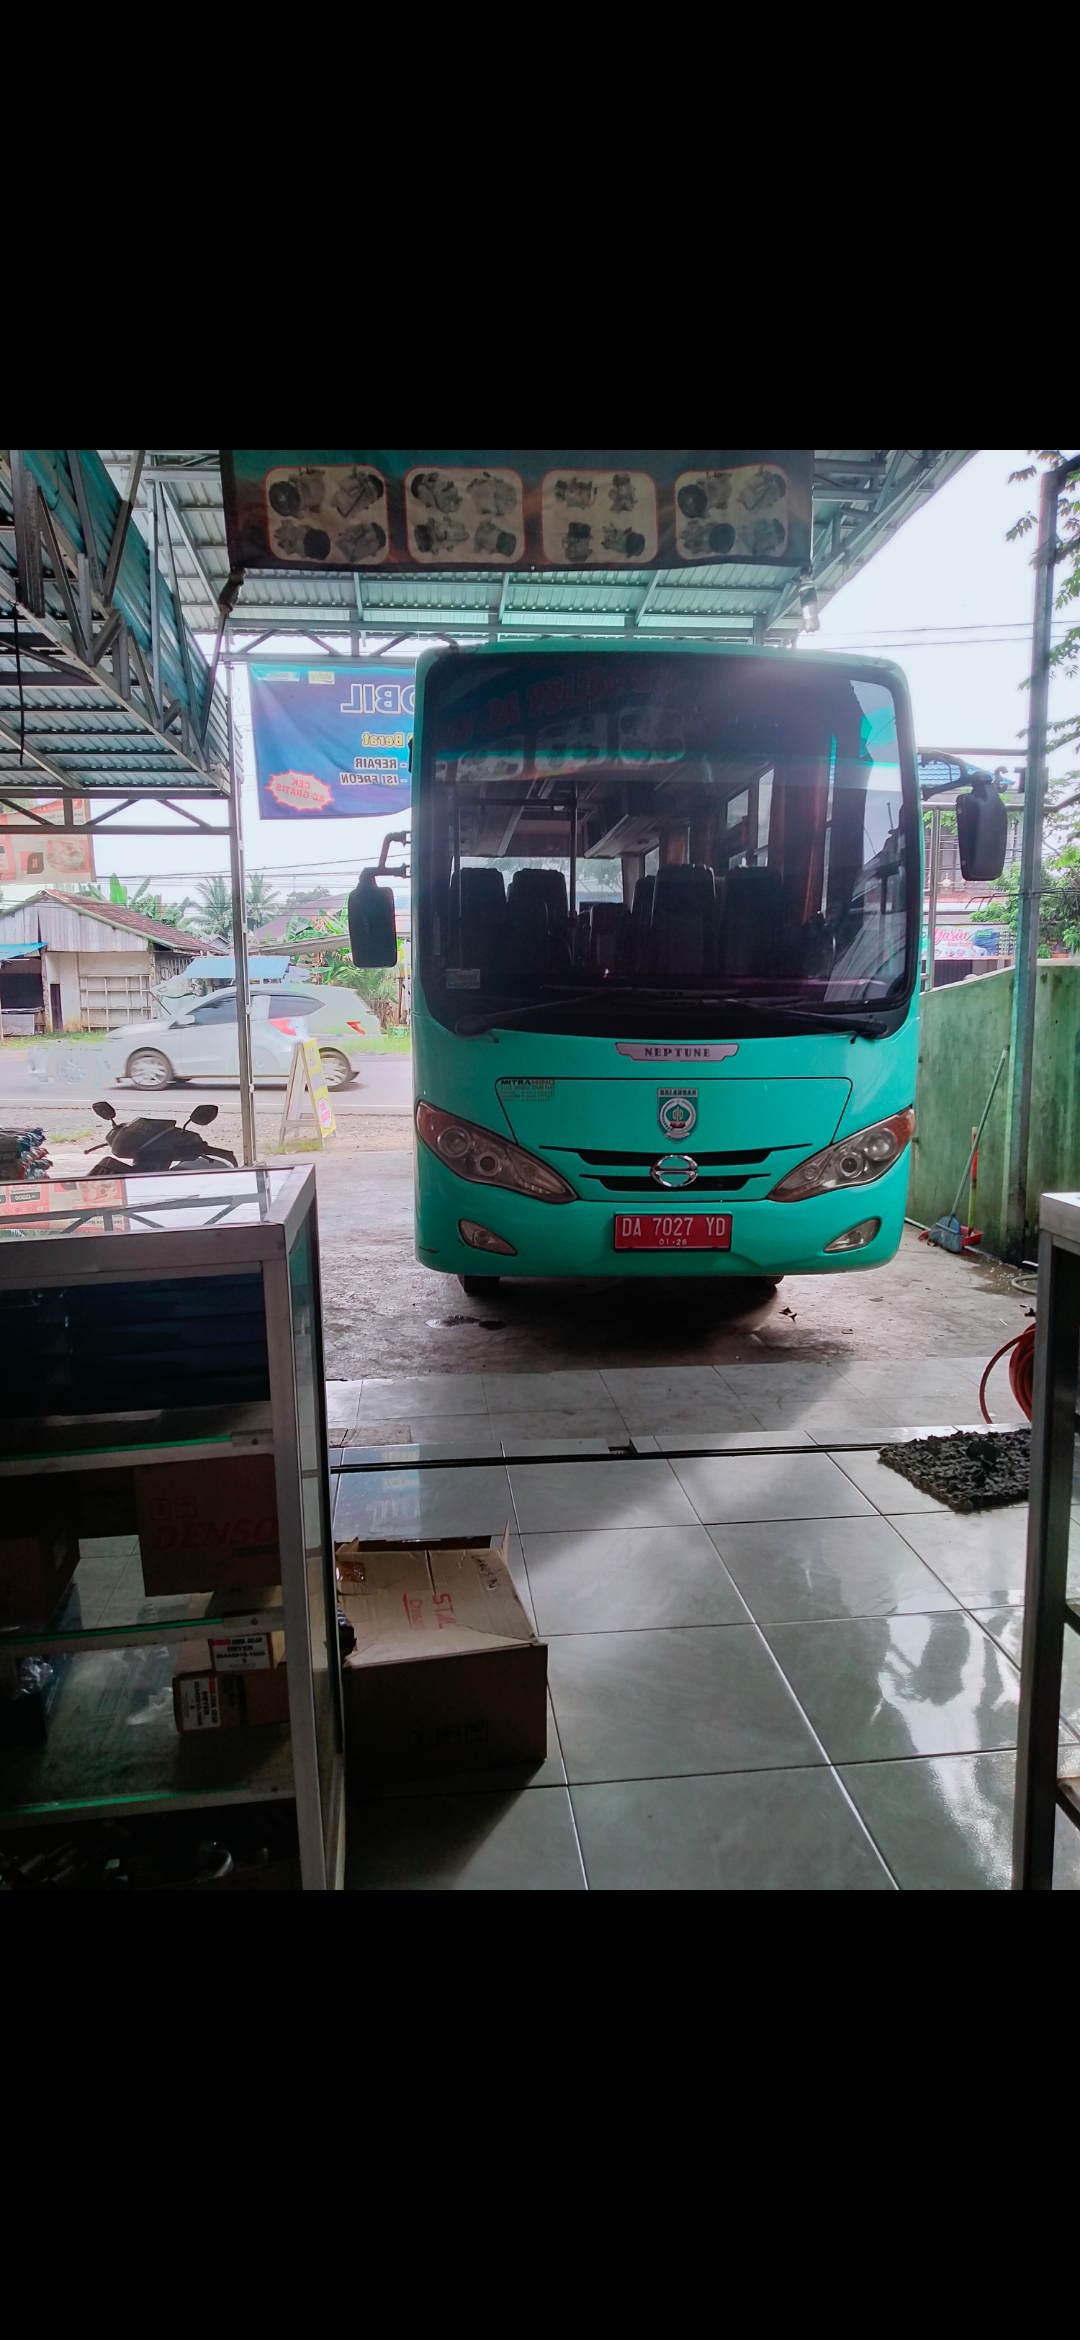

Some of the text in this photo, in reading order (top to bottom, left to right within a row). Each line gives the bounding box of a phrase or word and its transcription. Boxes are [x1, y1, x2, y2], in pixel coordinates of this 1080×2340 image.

[935, 927, 969, 945] Yasin
[644, 1047, 711, 1058] NEPTUNE
[621, 1216, 726, 1237] DA 7027 YD
[152, 1517, 278, 1551] DENSO
